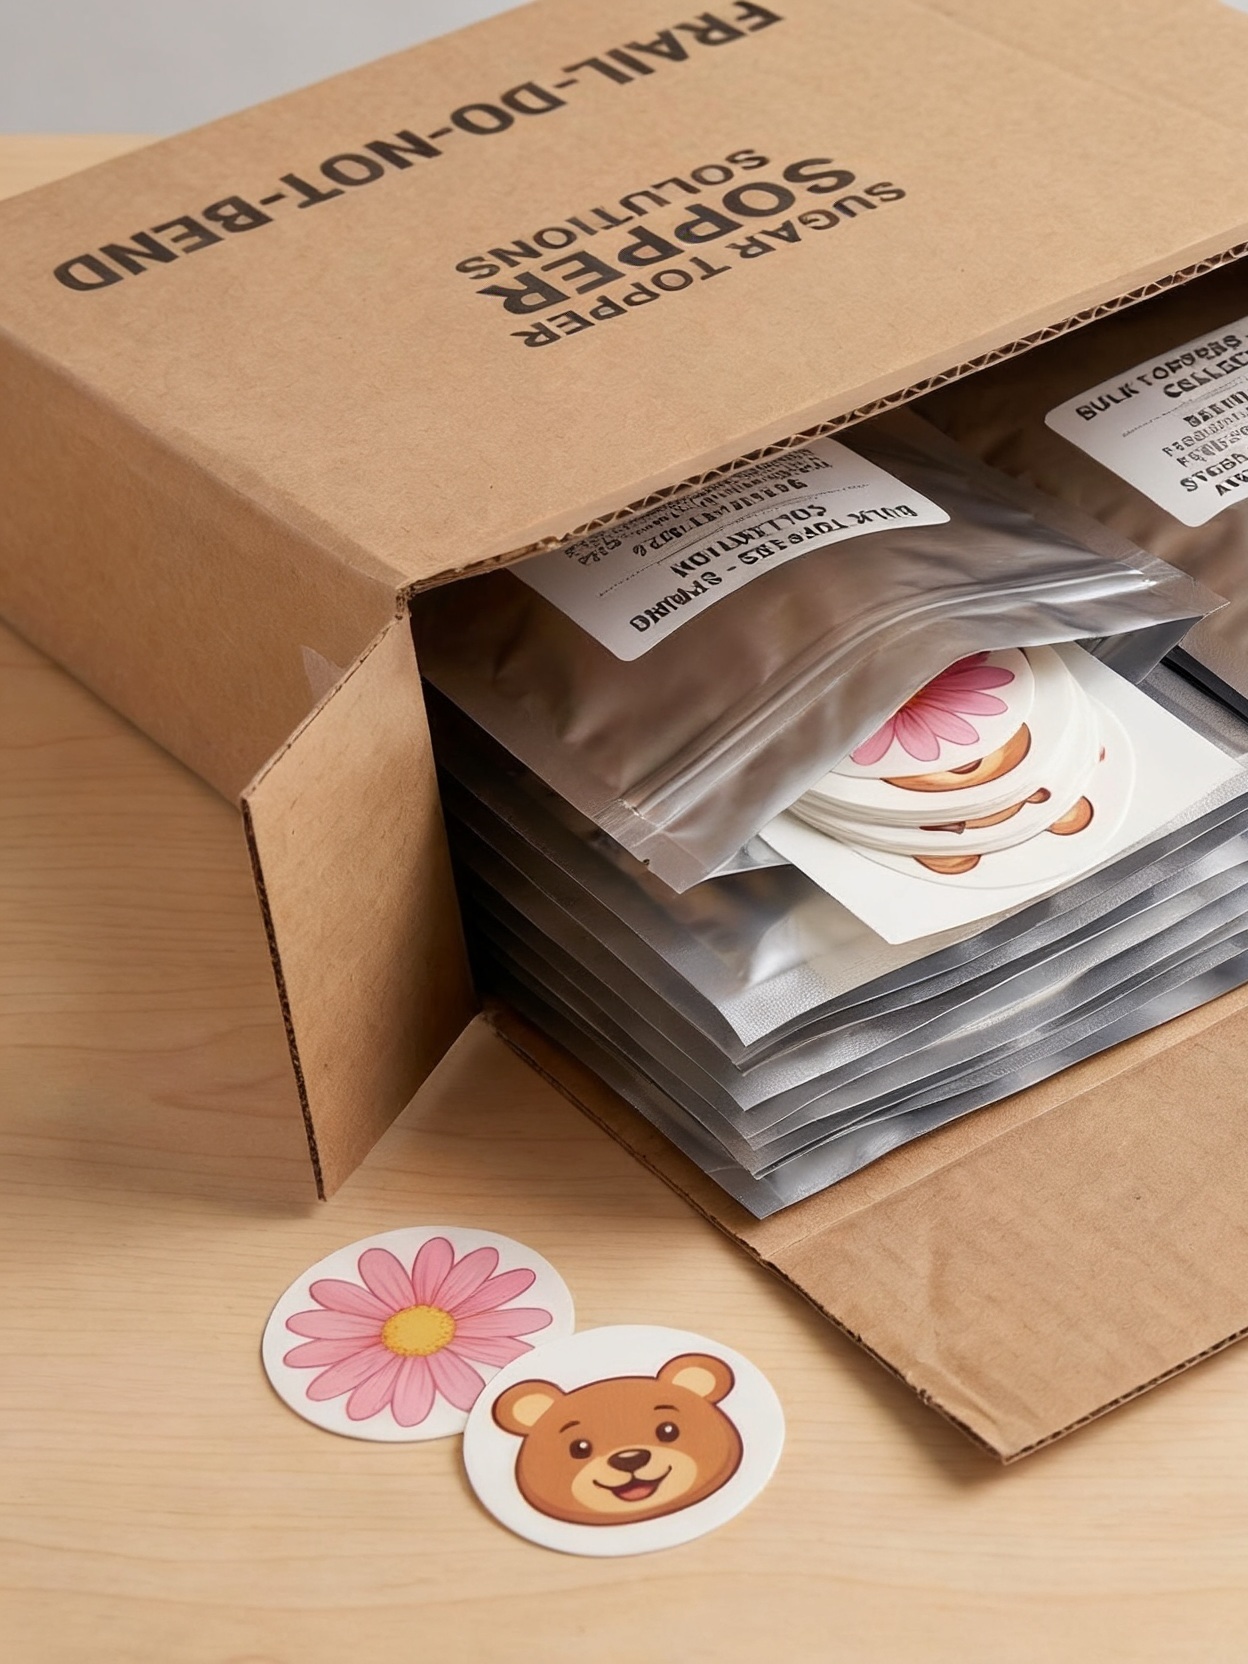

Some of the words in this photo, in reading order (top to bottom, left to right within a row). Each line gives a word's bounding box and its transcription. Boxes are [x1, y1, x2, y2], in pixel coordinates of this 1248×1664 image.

[52, 0, 784, 293] FRAIL-DO-NOT-BEND
[456, 150, 769, 279] SOLUTIONS
[478, 158, 858, 315] SOPPER
[727, 182, 905, 258] SUGAR
[510, 257, 731, 347] TOPPER
